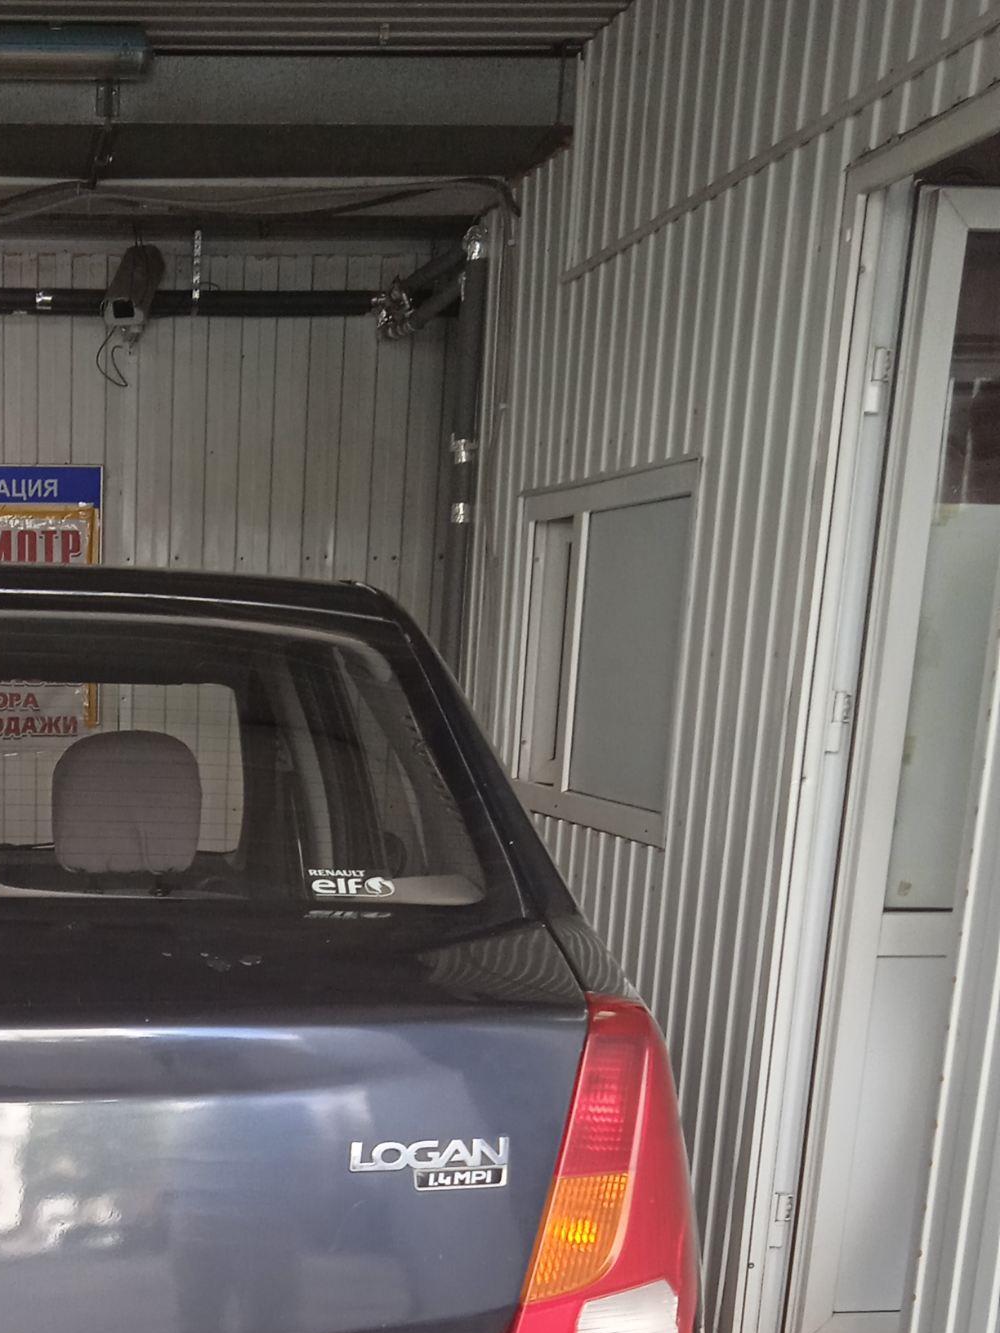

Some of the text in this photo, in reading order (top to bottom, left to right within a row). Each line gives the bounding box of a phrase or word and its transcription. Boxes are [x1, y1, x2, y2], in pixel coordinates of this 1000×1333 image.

[308, 868, 366, 878] RENAULT
[311, 877, 363, 895] elf
[349, 1137, 510, 1173] LOGAN
